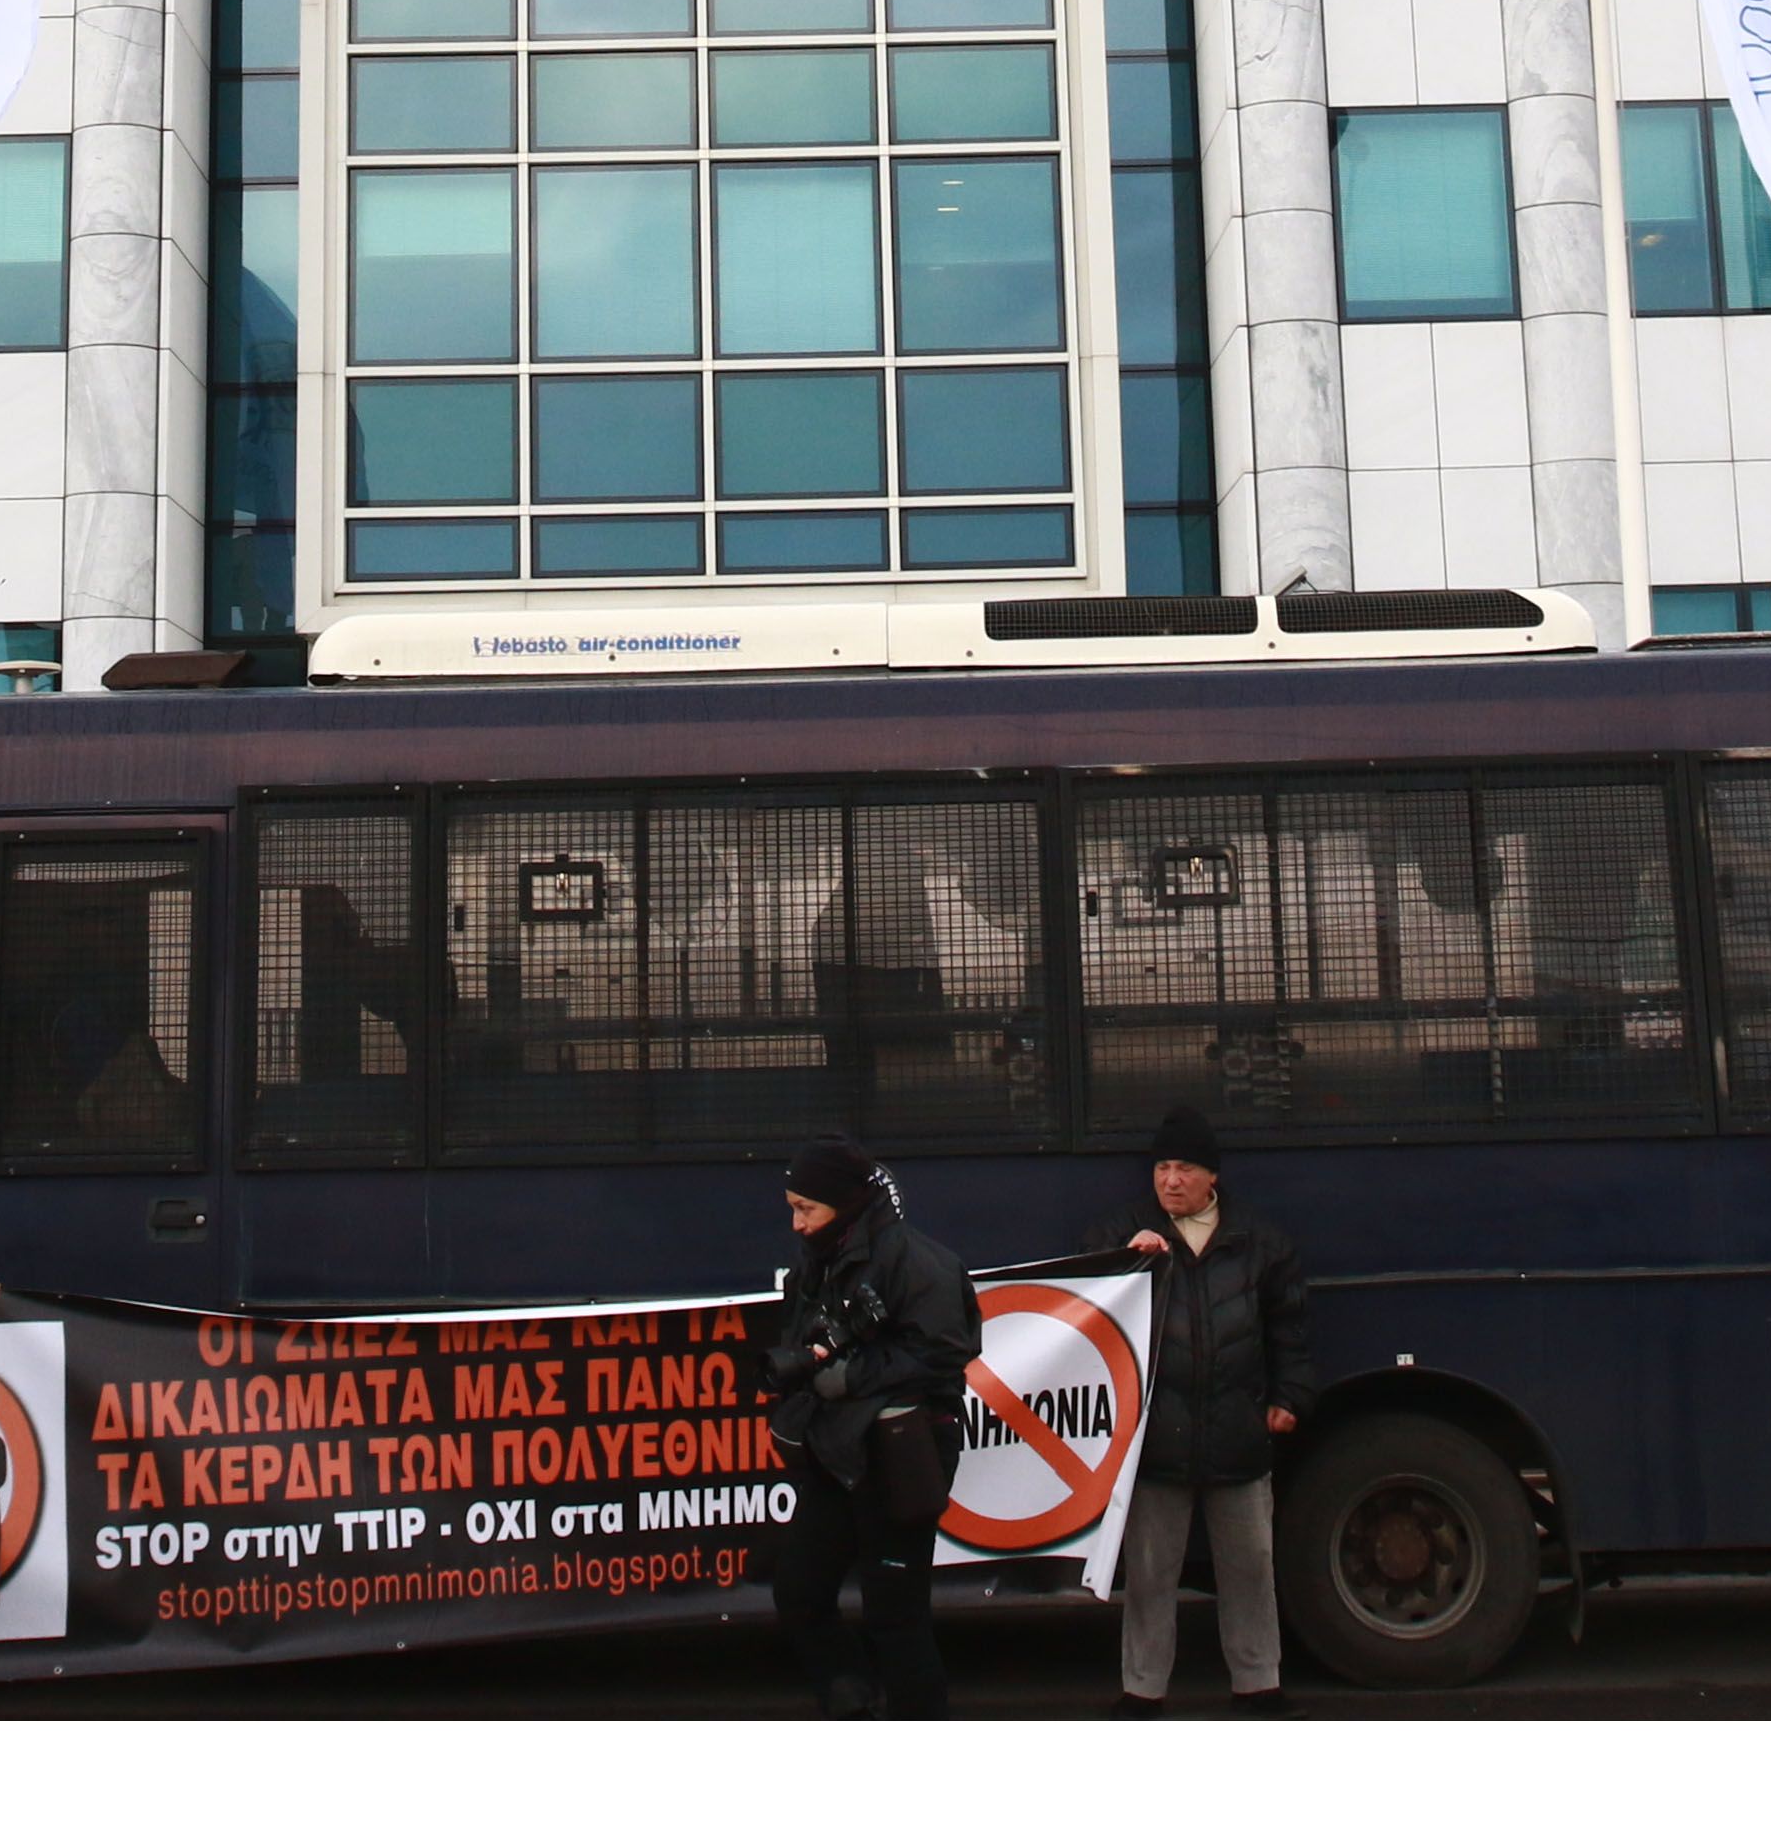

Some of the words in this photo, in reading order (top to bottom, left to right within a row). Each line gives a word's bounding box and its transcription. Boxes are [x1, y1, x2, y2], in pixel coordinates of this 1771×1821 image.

[577, 633, 741, 654] air-conditioner
[197, 1316, 254, 1367] ΟΙ
[91, 1367, 434, 1442] ΔΙΚΑΙΩΜΑΤΑ
[454, 1360, 567, 1420] ΜΑΣ
[586, 1351, 738, 1413] ΠΑΝΩ
[96, 1451, 165, 1512] ΤΑ
[183, 1439, 352, 1507] ΚΕΡΔΗ
[368, 1431, 473, 1495] ΤΩΝ
[95, 1521, 209, 1570] STOP
[222, 1522, 323, 1567] στην
[465, 1499, 537, 1545] ΟΧΙ
[550, 1499, 624, 1538] στα
[637, 1482, 797, 1531] ΜΝΗΜΟ
[157, 1543, 749, 1627] stopttipstopmnimonia.blogspot.gr
